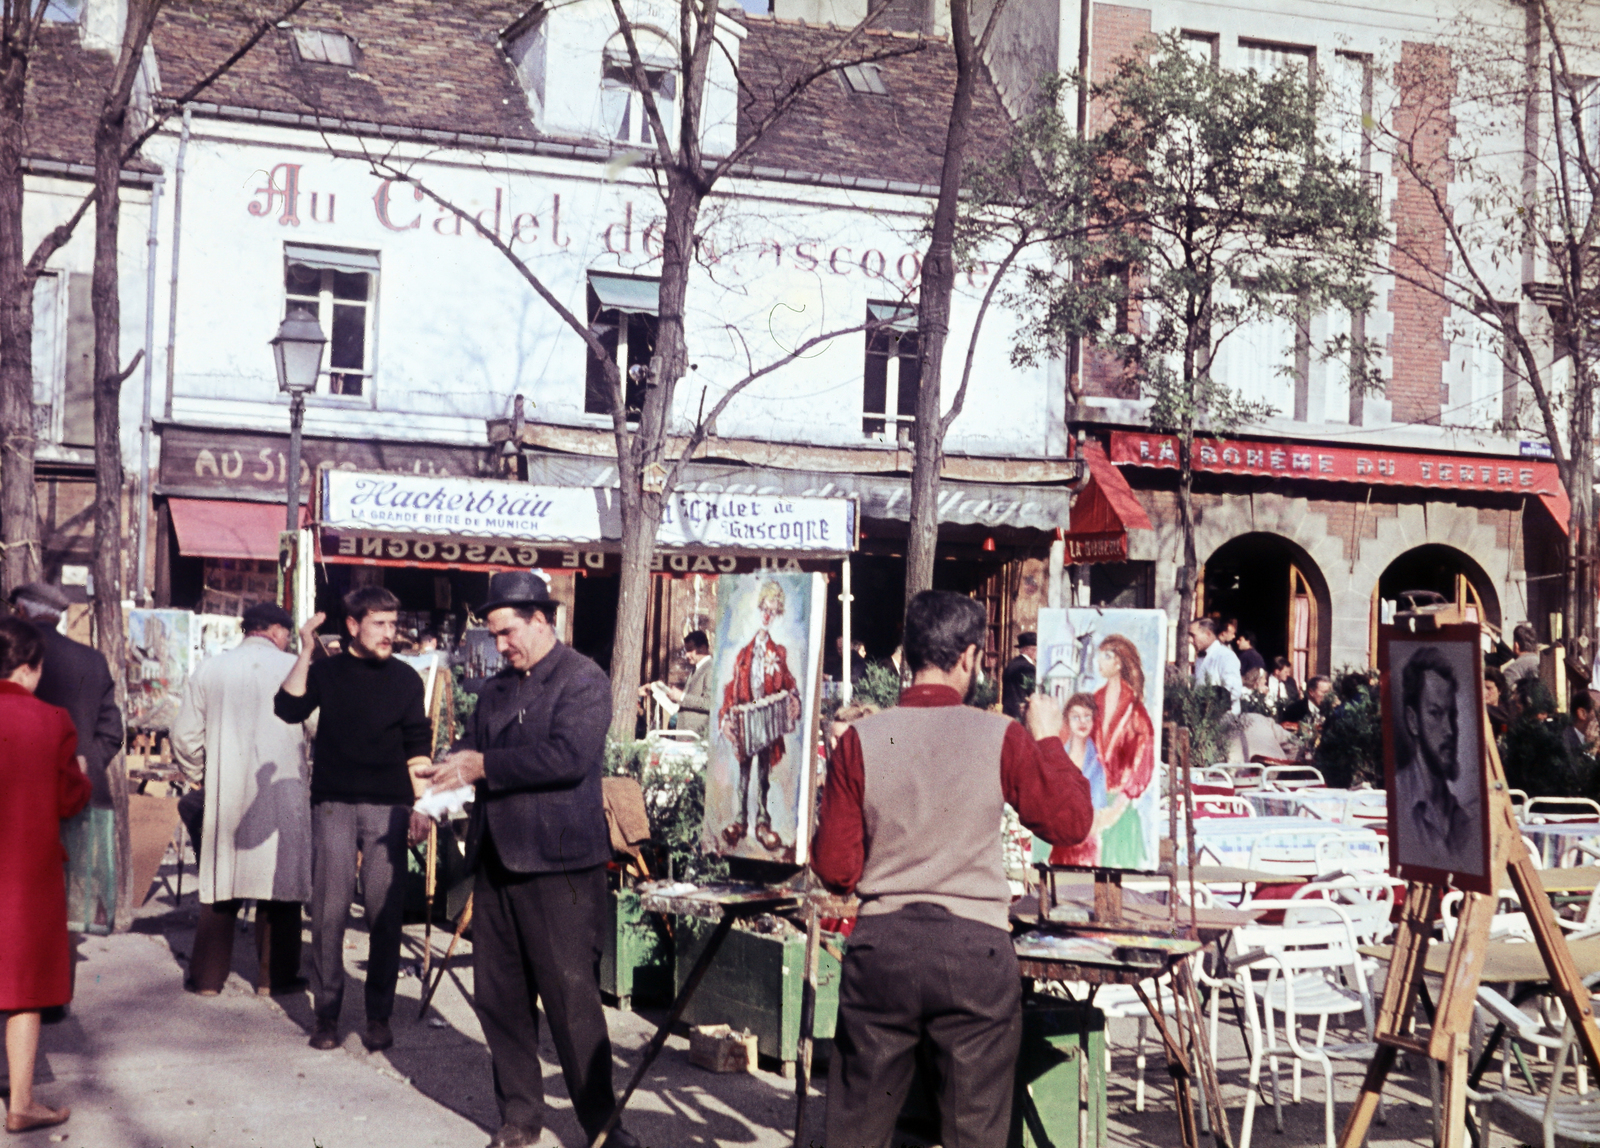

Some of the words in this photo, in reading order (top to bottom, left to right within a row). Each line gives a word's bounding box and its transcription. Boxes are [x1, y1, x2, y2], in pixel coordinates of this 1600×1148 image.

[247, 162, 336, 227] Au
[1140, 440, 1178, 462] LA
[1356, 457, 1396, 477] DU
[1419, 461, 1534, 487] TERTRE
[351, 509, 366, 520] LA
[370, 511, 419, 523] GRANDE
[465, 517, 481, 528] DE
[485, 519, 539, 531] MUNICH
